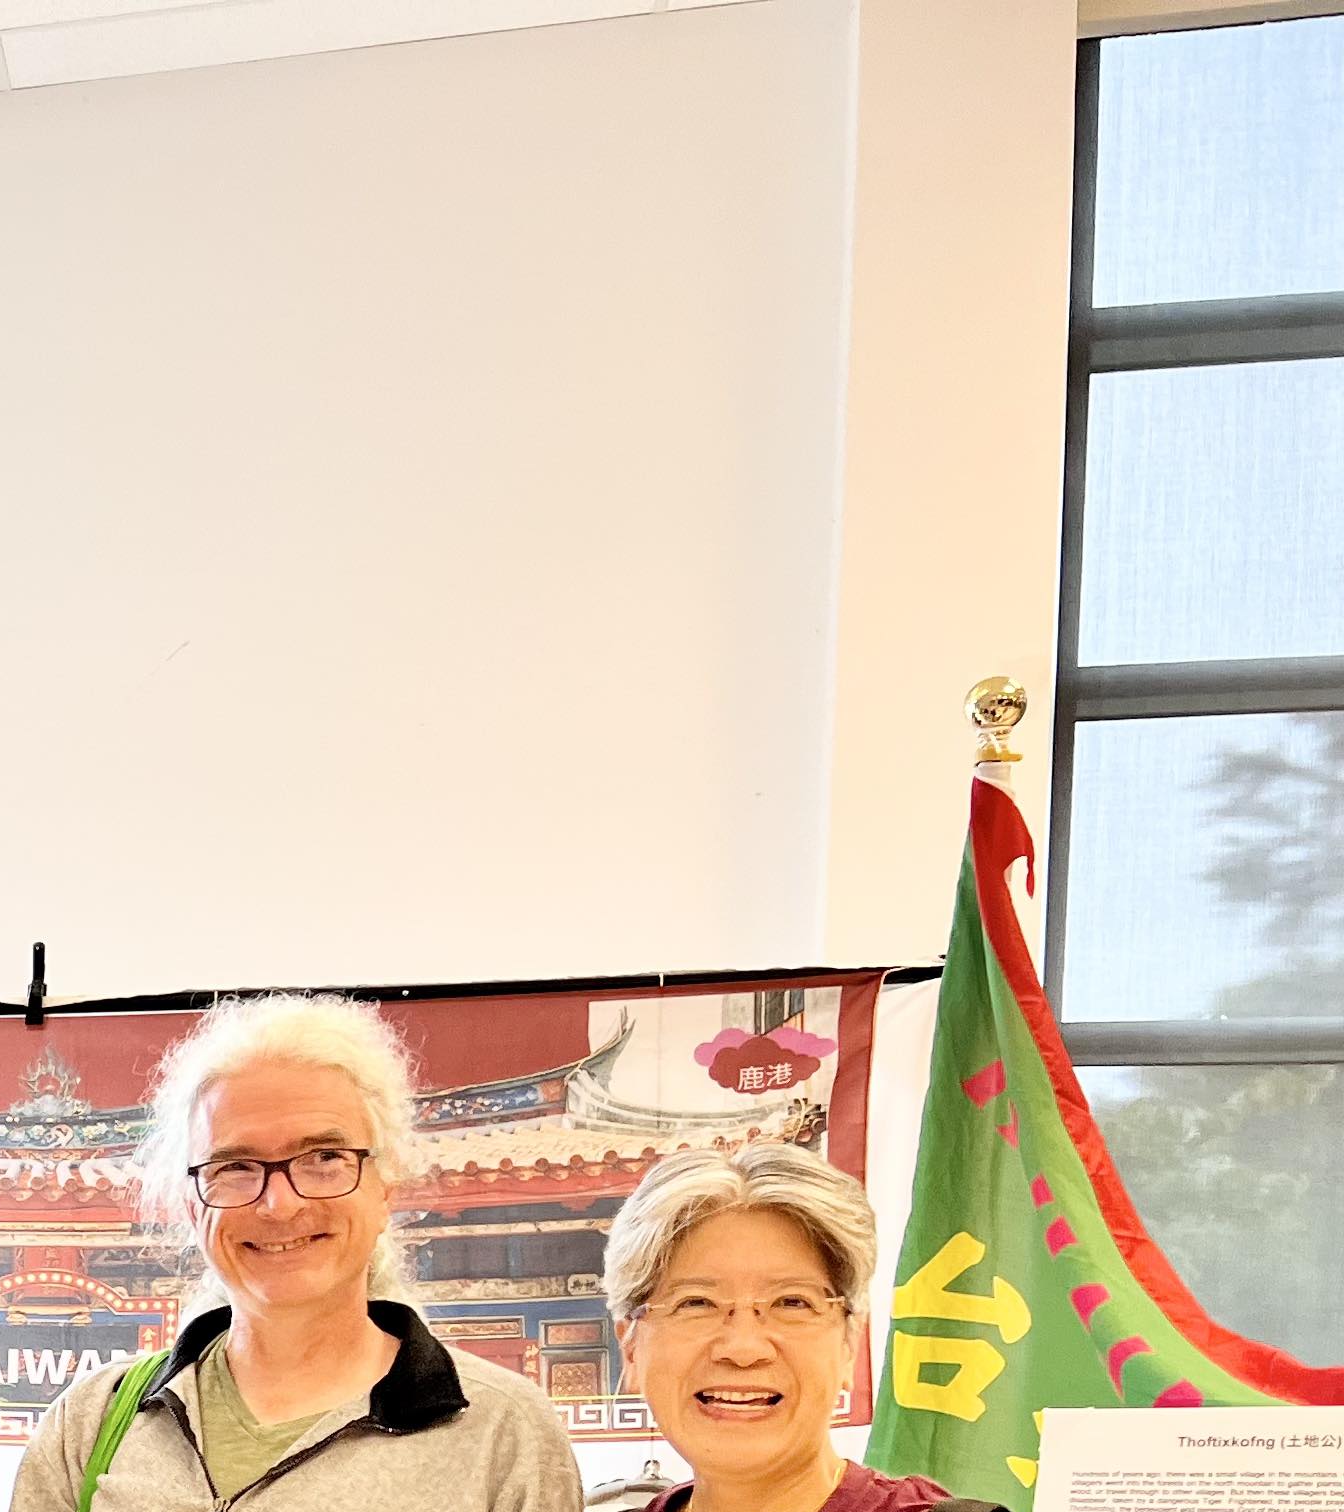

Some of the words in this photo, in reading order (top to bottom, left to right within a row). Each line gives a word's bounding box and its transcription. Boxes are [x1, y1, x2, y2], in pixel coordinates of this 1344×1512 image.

[738, 1061, 794, 1091] 鹿港
[891, 1231, 1032, 1422] 台
[1178, 1436, 1276, 1450] Thoftixkofng
